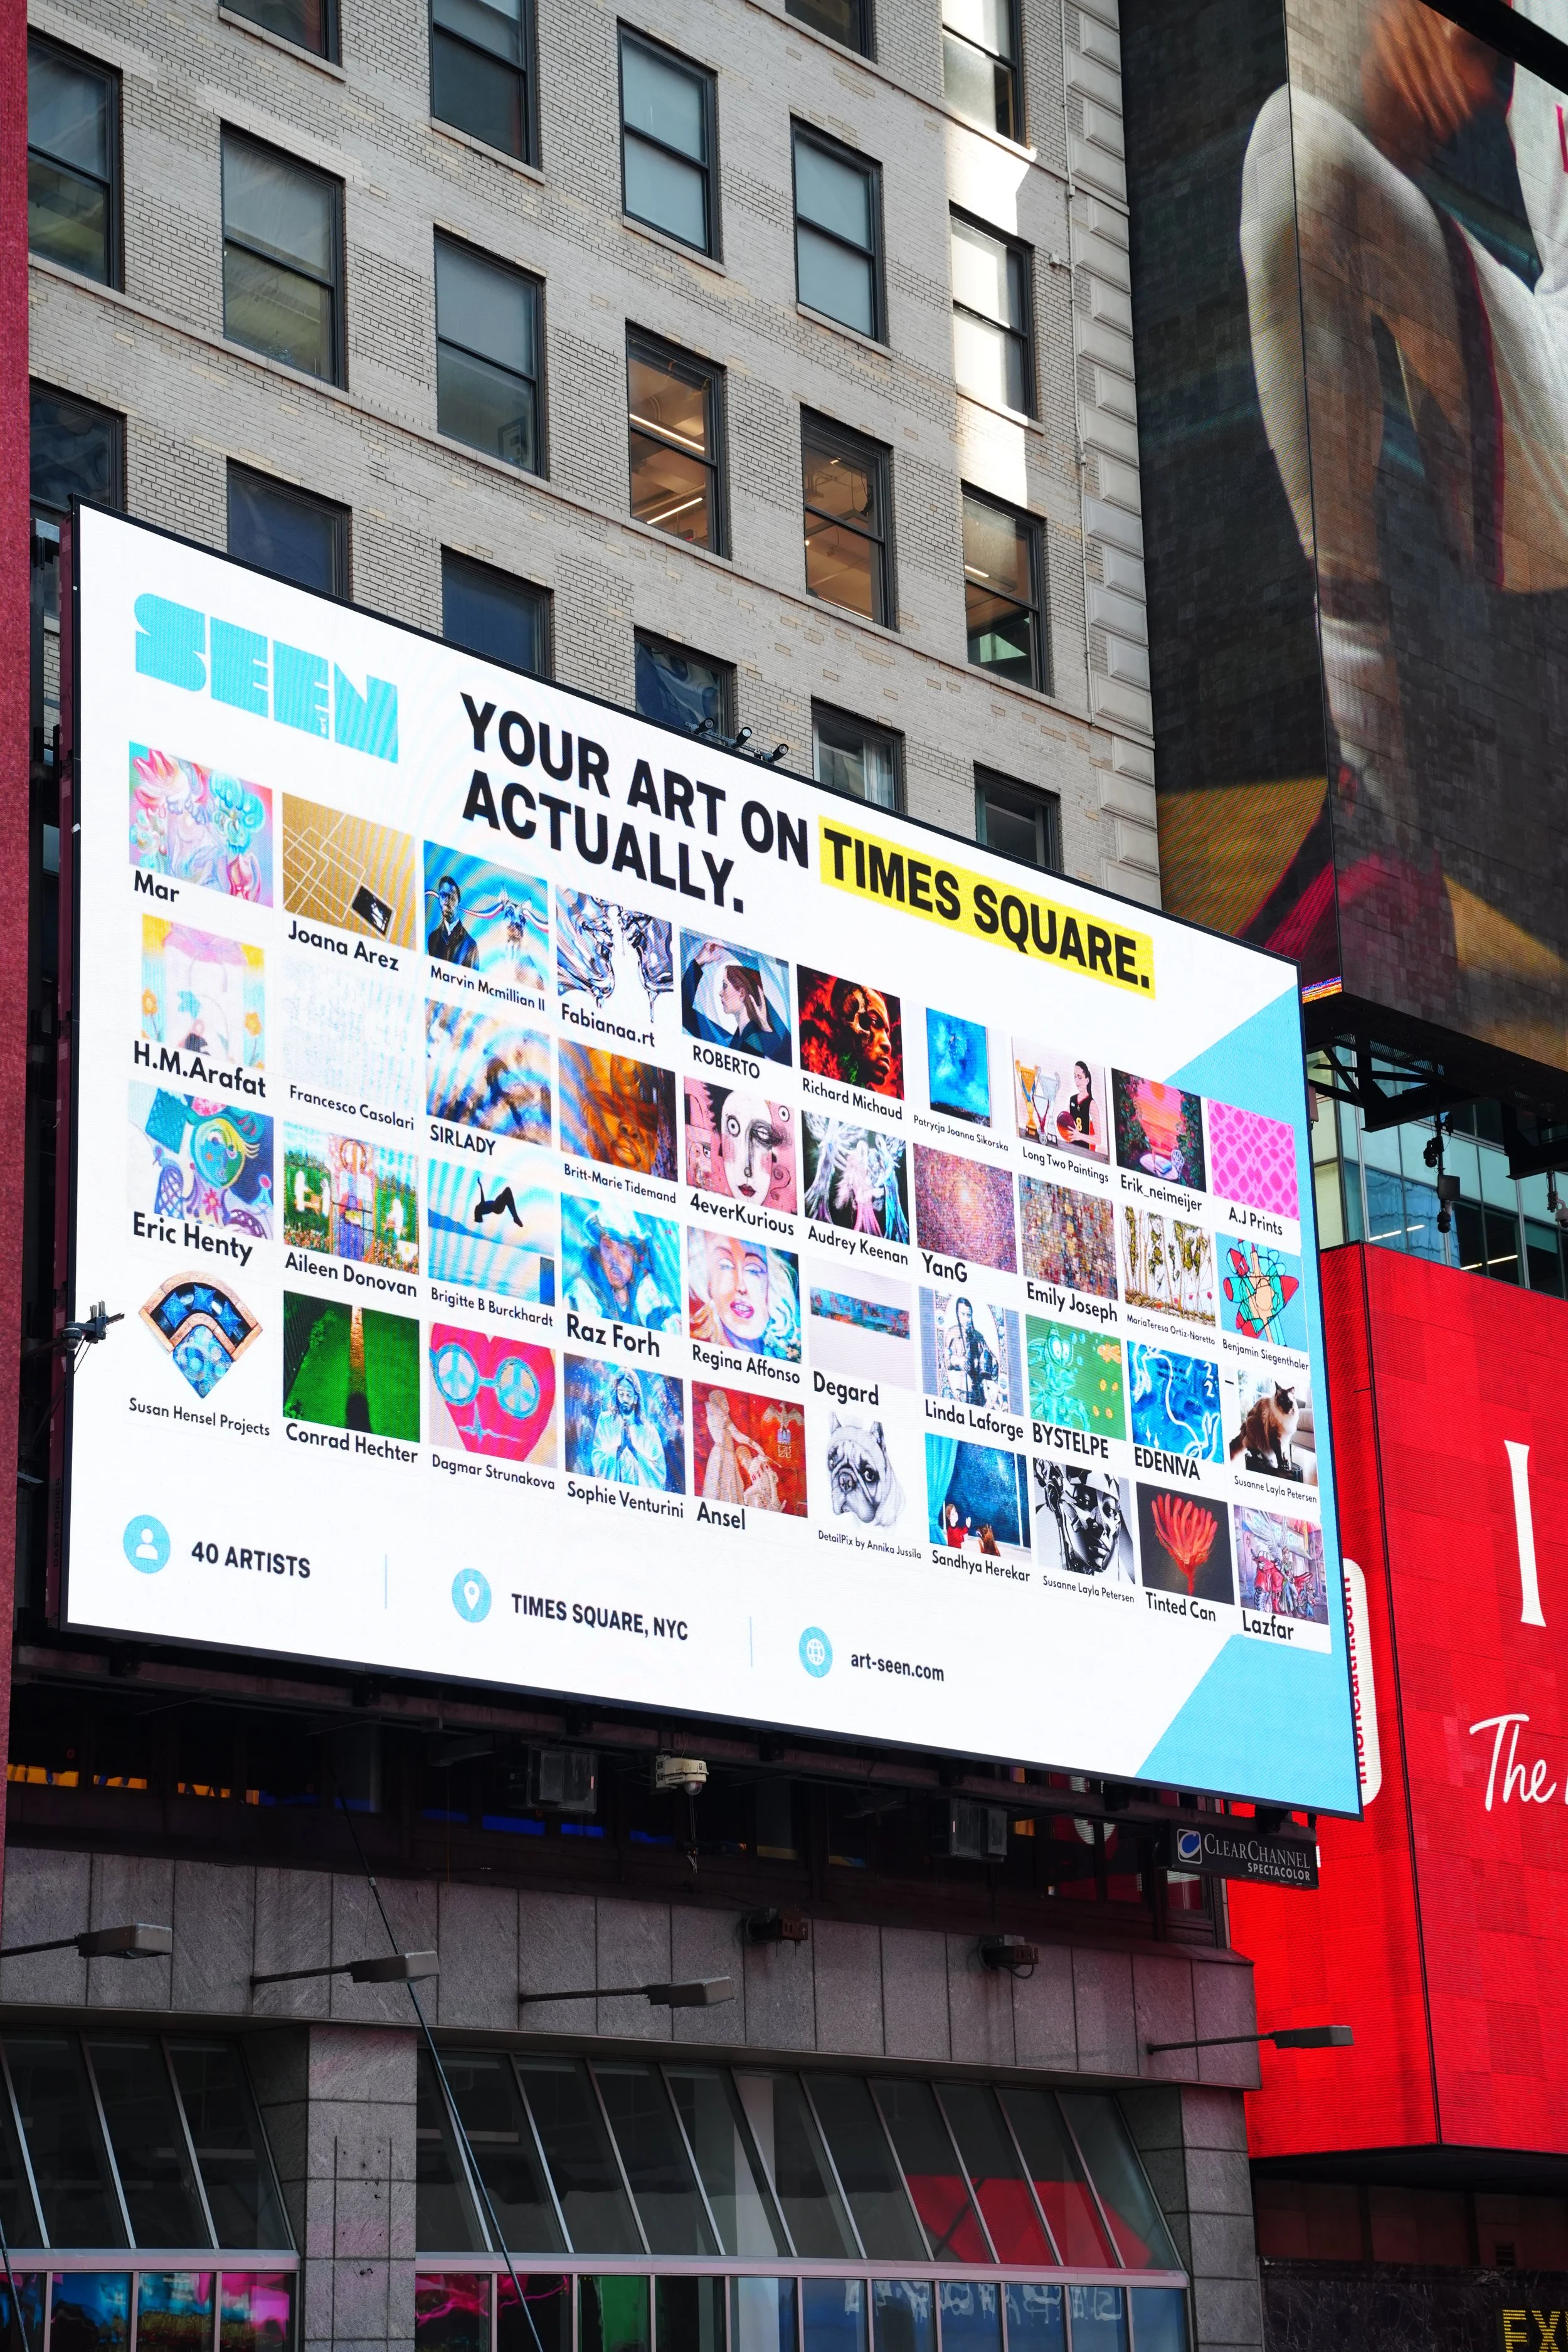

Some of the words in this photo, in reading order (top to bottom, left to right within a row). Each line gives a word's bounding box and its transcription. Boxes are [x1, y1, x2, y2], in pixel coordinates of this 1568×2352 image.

[134, 593, 398, 763] SEEN
[460, 692, 611, 798] YOUR
[627, 758, 726, 837] ART
[741, 800, 808, 869] ON
[824, 827, 961, 921] TIMES
[973, 882, 1150, 990] SQUARE.
[462, 768, 744, 916] ACTUALLY.
[134, 870, 180, 903] Mar
[288, 920, 348, 956] Joana
[353, 941, 399, 972] Arez
[430, 965, 474, 990] Marvin
[478, 979, 535, 1009] Mcmillian
[561, 1001, 655, 1047] Fabianaa.rt
[134, 1040, 266, 1098] H.M.Arafat
[693, 1044, 760, 1079] ROBERTO
[290, 1084, 356, 1115] Francesco
[359, 1104, 414, 1130] Casolari
[802, 1077, 849, 1104] Richard
[852, 1093, 903, 1120] Michaud
[430, 1124, 496, 1156] SIRLADY
[914, 1115, 945, 1133] Patrycja
[947, 1125, 975, 1141] Joanna
[977, 1133, 1009, 1152] Sikorska
[564, 1163, 622, 1190] Britt-Marie
[625, 1179, 676, 1204] Tidemand
[1022, 1147, 1045, 1166] Long
[1046, 1153, 1066, 1169] Two
[1068, 1160, 1109, 1184] Paintings
[1120, 1173, 1202, 1212] Erik_neimeijer
[689, 1193, 795, 1236] 4everKurious
[1229, 1207, 1246, 1225] A.J
[1249, 1212, 1283, 1236] Prints
[134, 1211, 176, 1244] Eric
[184, 1222, 253, 1267] Henty
[808, 1225, 856, 1255] Audrey
[860, 1238, 908, 1265] Keenan
[285, 1252, 338, 1279] Aileen
[344, 1264, 417, 1298] Donovan
[921, 1252, 968, 1283] YanG
[432, 1286, 475, 1308] Brigitte
[478, 1298, 485, 1311] B
[489, 1300, 553, 1327] Burckhardt
[1027, 1281, 1066, 1313] Emily
[1069, 1293, 1118, 1323] Joseph
[566, 1313, 607, 1345] Raz
[613, 1323, 660, 1357] Forh
[1127, 1314, 1168, 1333] MariaTeresa
[1170, 1325, 1216, 1345] Ortiz-Naretto
[692, 1343, 742, 1371] Regina
[746, 1357, 800, 1384] Affonso
[1222, 1338, 1259, 1357] Benjamin
[1261, 1348, 1309, 1370] Siegenthaler
[813, 1370, 879, 1406] Degard
[129, 1397, 169, 1417] Susan
[174, 1405, 216, 1426] Hensel
[220, 1414, 270, 1436] Projects
[925, 1397, 965, 1425] Linda
[969, 1409, 1024, 1442] Laforge
[285, 1422, 349, 1451] Conrad
[355, 1435, 418, 1463] Hechter
[1032, 1422, 1110, 1459] BYSTELPE
[432, 1454, 482, 1476] Dagmar
[485, 1464, 555, 1490] Strunakova
[1234, 1475, 1264, 1491] Susanne
[1266, 1483, 1286, 1496] Layla
[1287, 1488, 1316, 1503] Petersen
[567, 1479, 617, 1505] Sophie
[618, 1490, 684, 1518] Venturini
[696, 1501, 746, 1530] Ansel
[191, 1541, 219, 1564] 40
[225, 1546, 310, 1579] ARTISTS
[818, 1530, 853, 1545] DetailPix
[856, 1537, 865, 1550] by
[867, 1540, 894, 1554] Annika
[896, 1546, 921, 1559] Jussila
[932, 1549, 982, 1575] Sandhya
[985, 1560, 1030, 1582] Herekar
[1043, 1575, 1076, 1591] Susanne
[1078, 1582, 1099, 1597] Layla
[1101, 1587, 1135, 1602] Petersen
[1145, 1591, 1187, 1616] Tinted
[1190, 1601, 1216, 1622] Can
[511, 1593, 567, 1621] TIMES
[572, 1603, 649, 1638] SQUARE,
[654, 1617, 688, 1641] NYC
[1242, 1608, 1295, 1640] Lazfar
[850, 1653, 944, 1682] art-seen.com
[1469, 1713, 1557, 1812] The
[1248, 1862, 1310, 1881] SPECTACOLOR
[1502, 2309, 1568, 2352] EX
